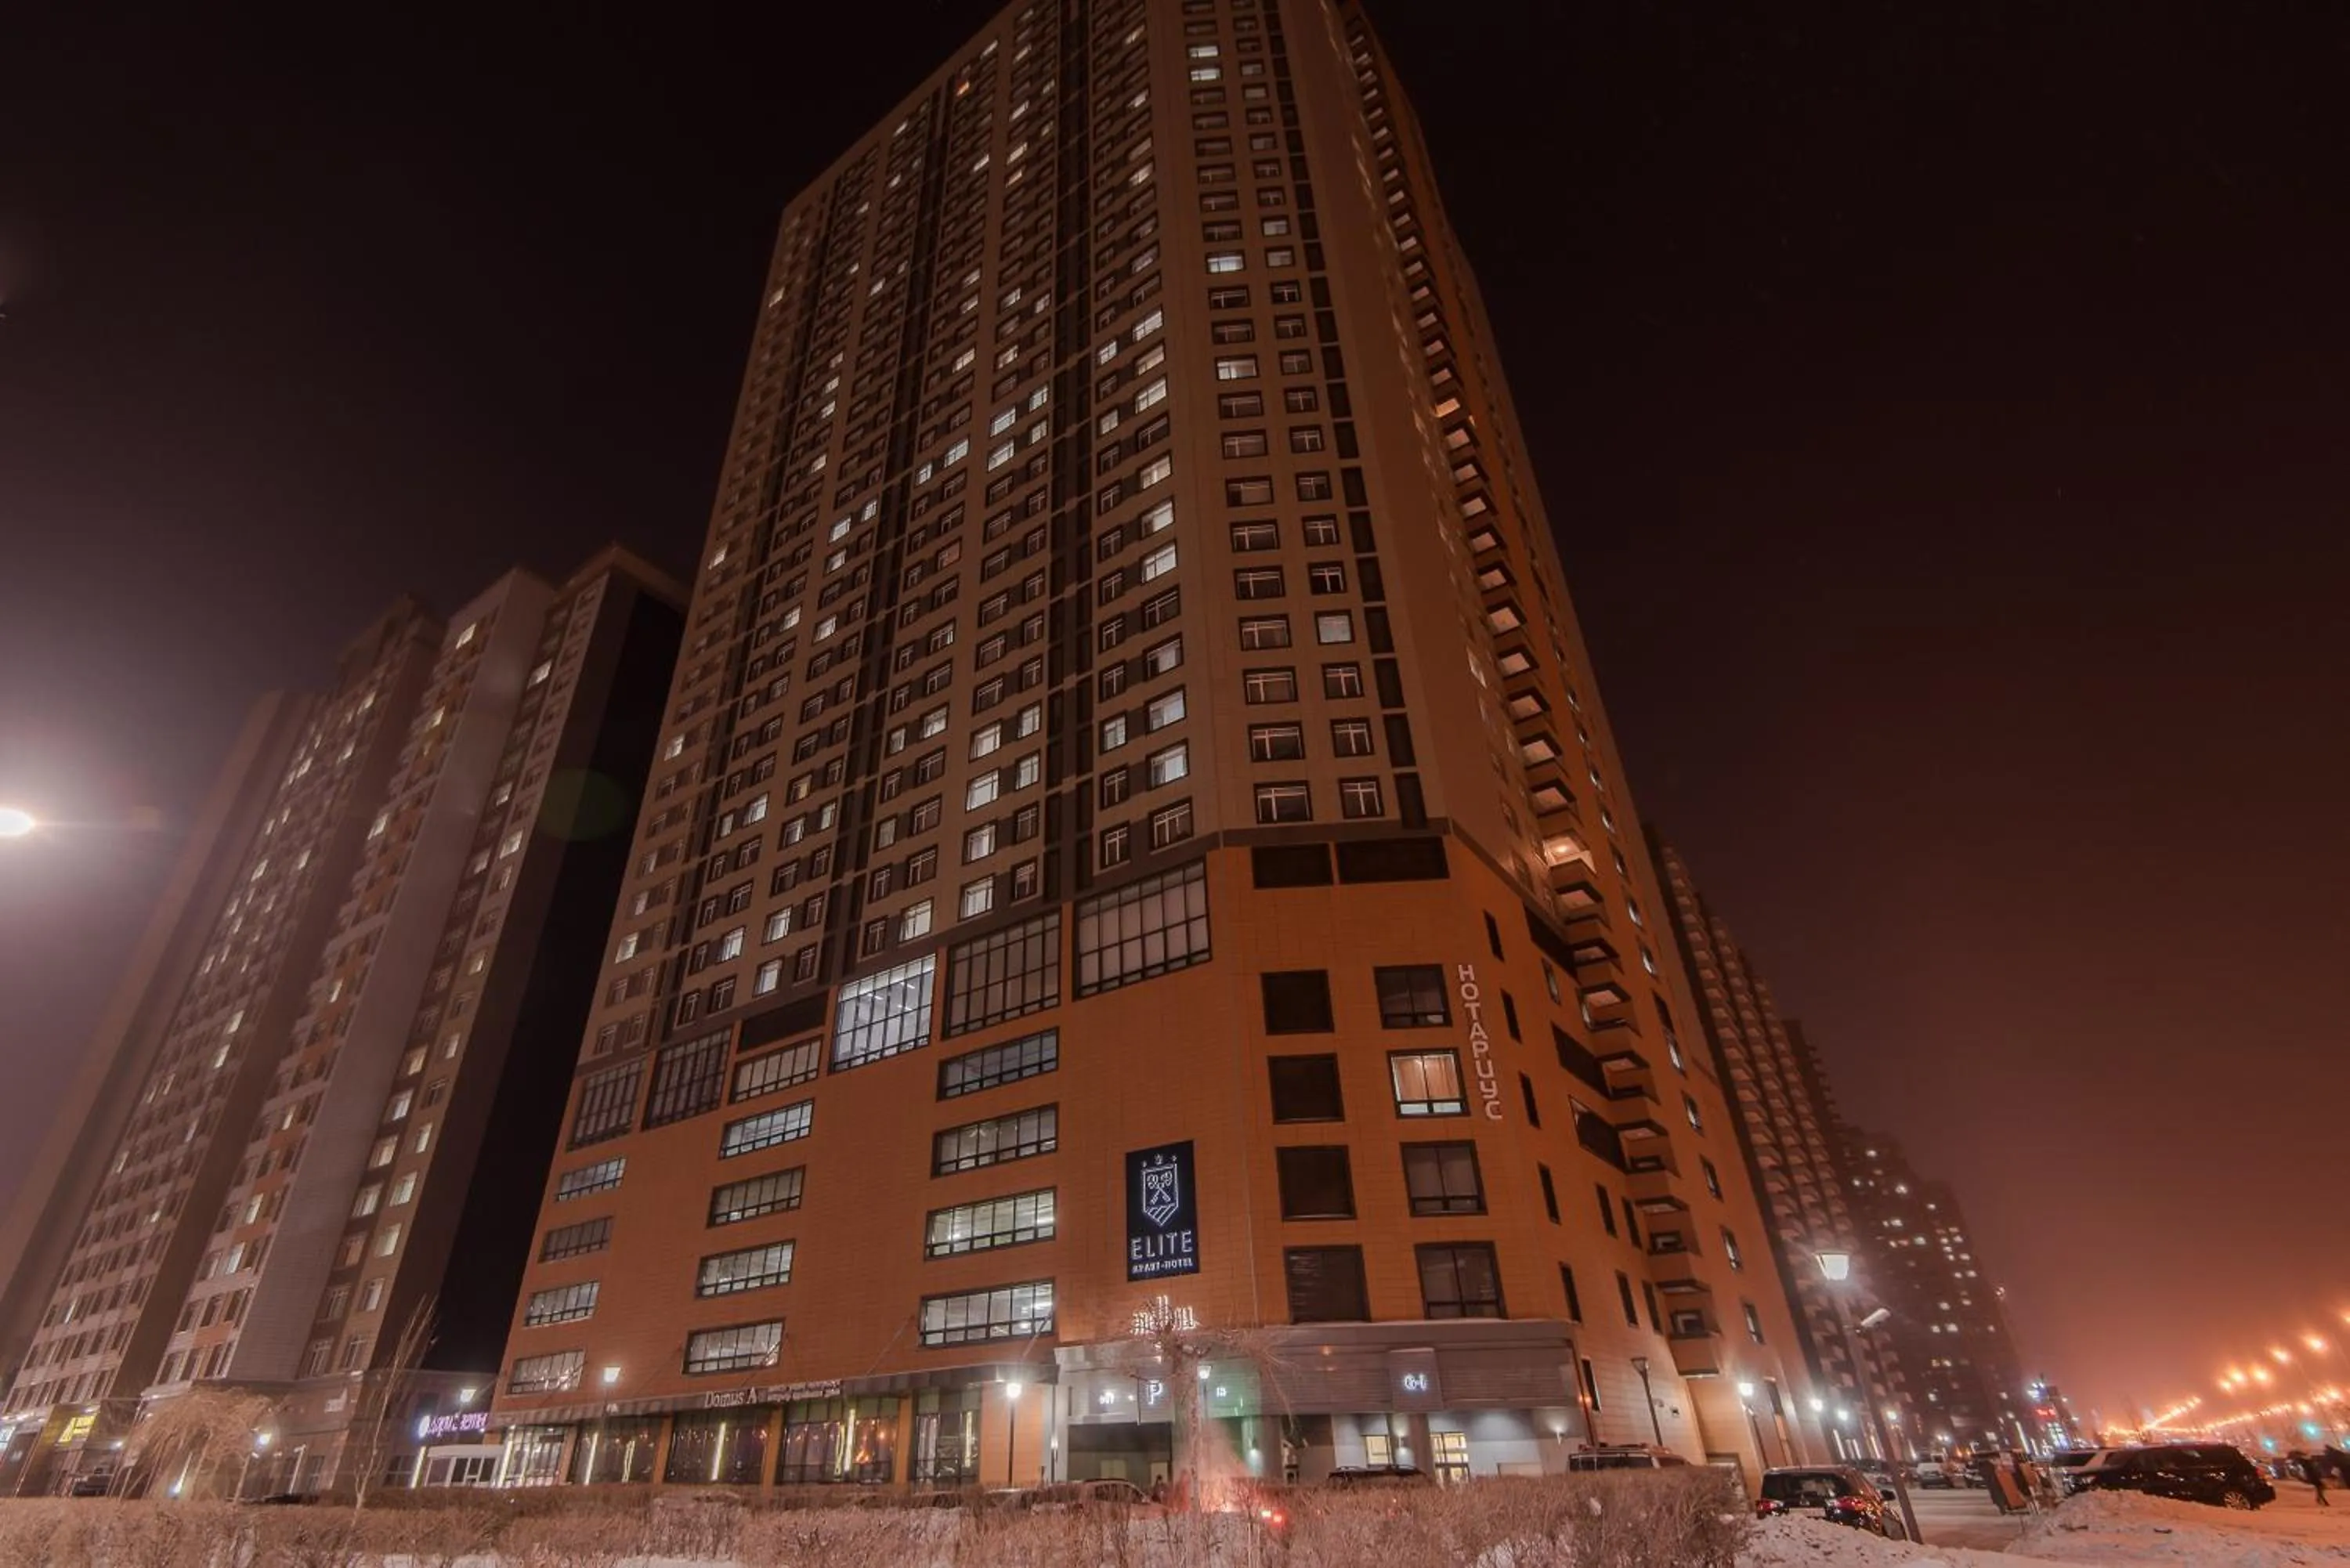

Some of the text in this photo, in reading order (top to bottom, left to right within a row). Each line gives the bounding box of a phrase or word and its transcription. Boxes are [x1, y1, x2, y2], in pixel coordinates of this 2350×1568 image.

[1458, 964, 1502, 1120] НОТАРИУС
[1130, 1230, 1193, 1260] ELITE
[704, 1390, 745, 1410] Domus
